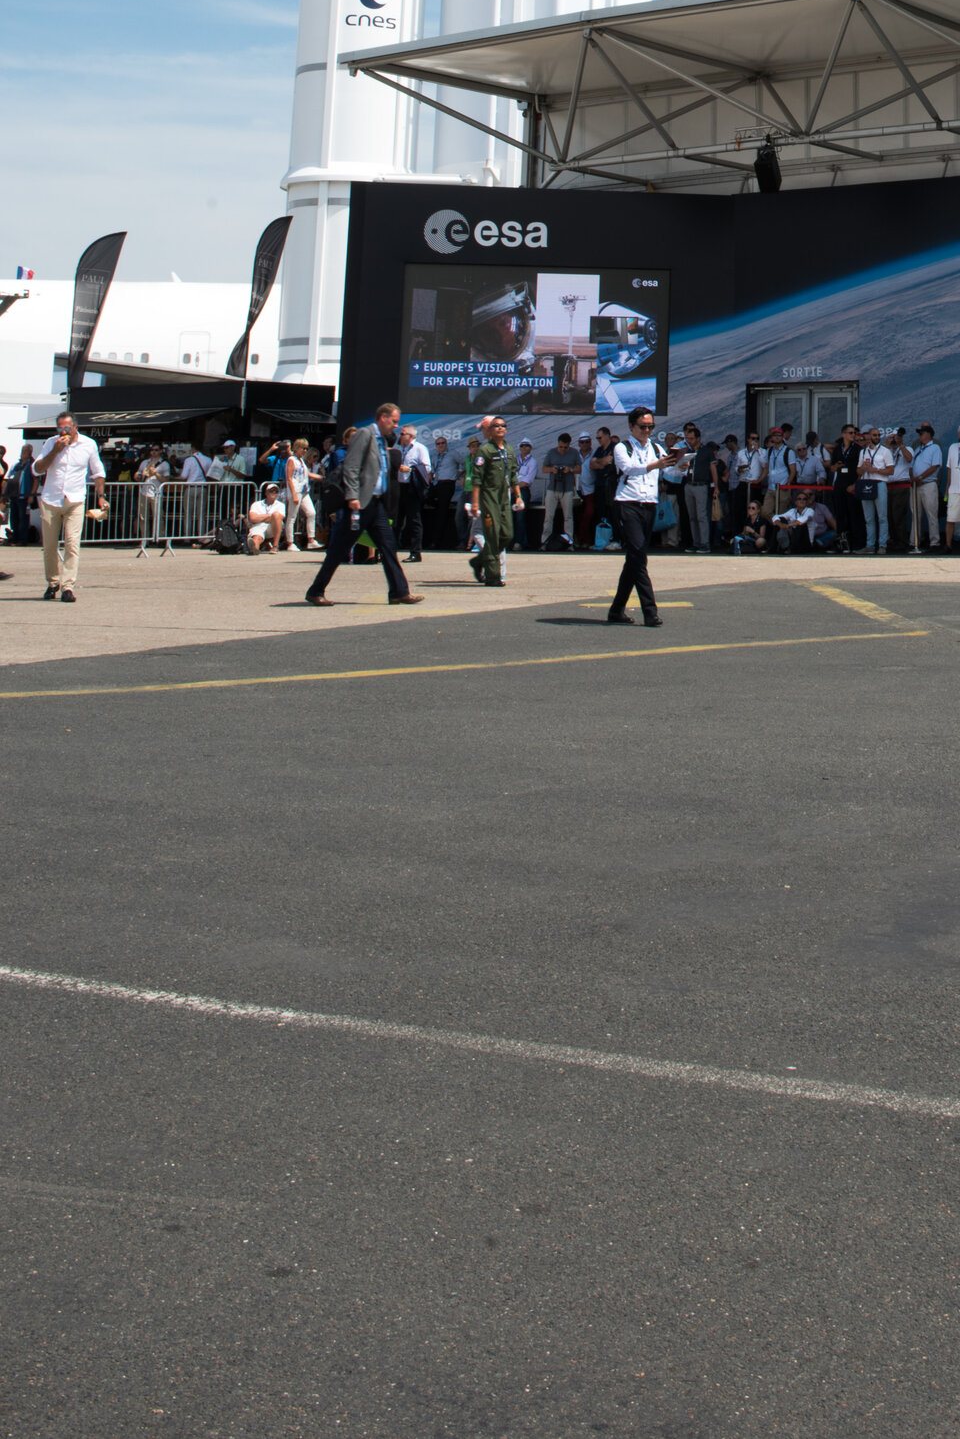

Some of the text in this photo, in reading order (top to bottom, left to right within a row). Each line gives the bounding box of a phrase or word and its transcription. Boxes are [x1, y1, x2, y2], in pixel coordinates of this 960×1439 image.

[345, 14, 396, 30] cnes
[473, 220, 548, 248] esa
[642, 278, 659, 288] esa
[424, 362, 515, 374] EUROPE'S VISION
[782, 366, 823, 379] SORTIE
[423, 376, 553, 388] FOR SPACE EXPLORATION
[90, 427, 113, 438] PAUL
